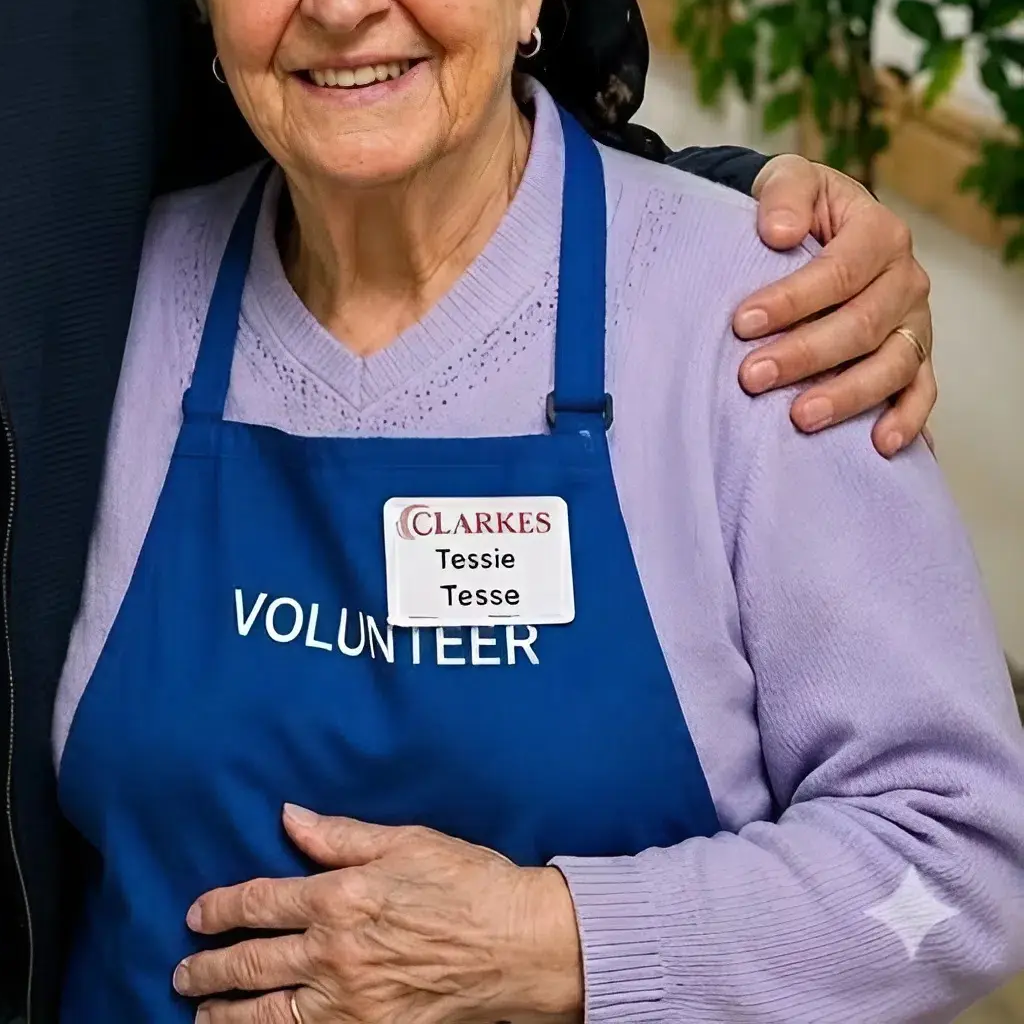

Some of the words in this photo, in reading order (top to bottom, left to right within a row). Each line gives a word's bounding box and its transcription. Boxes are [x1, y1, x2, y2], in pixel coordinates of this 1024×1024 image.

[412, 511, 552, 536] CLARKES
[435, 547, 516, 570] Tessie
[439, 584, 521, 607] Tesse
[233, 588, 540, 666] VOLUNTEER
